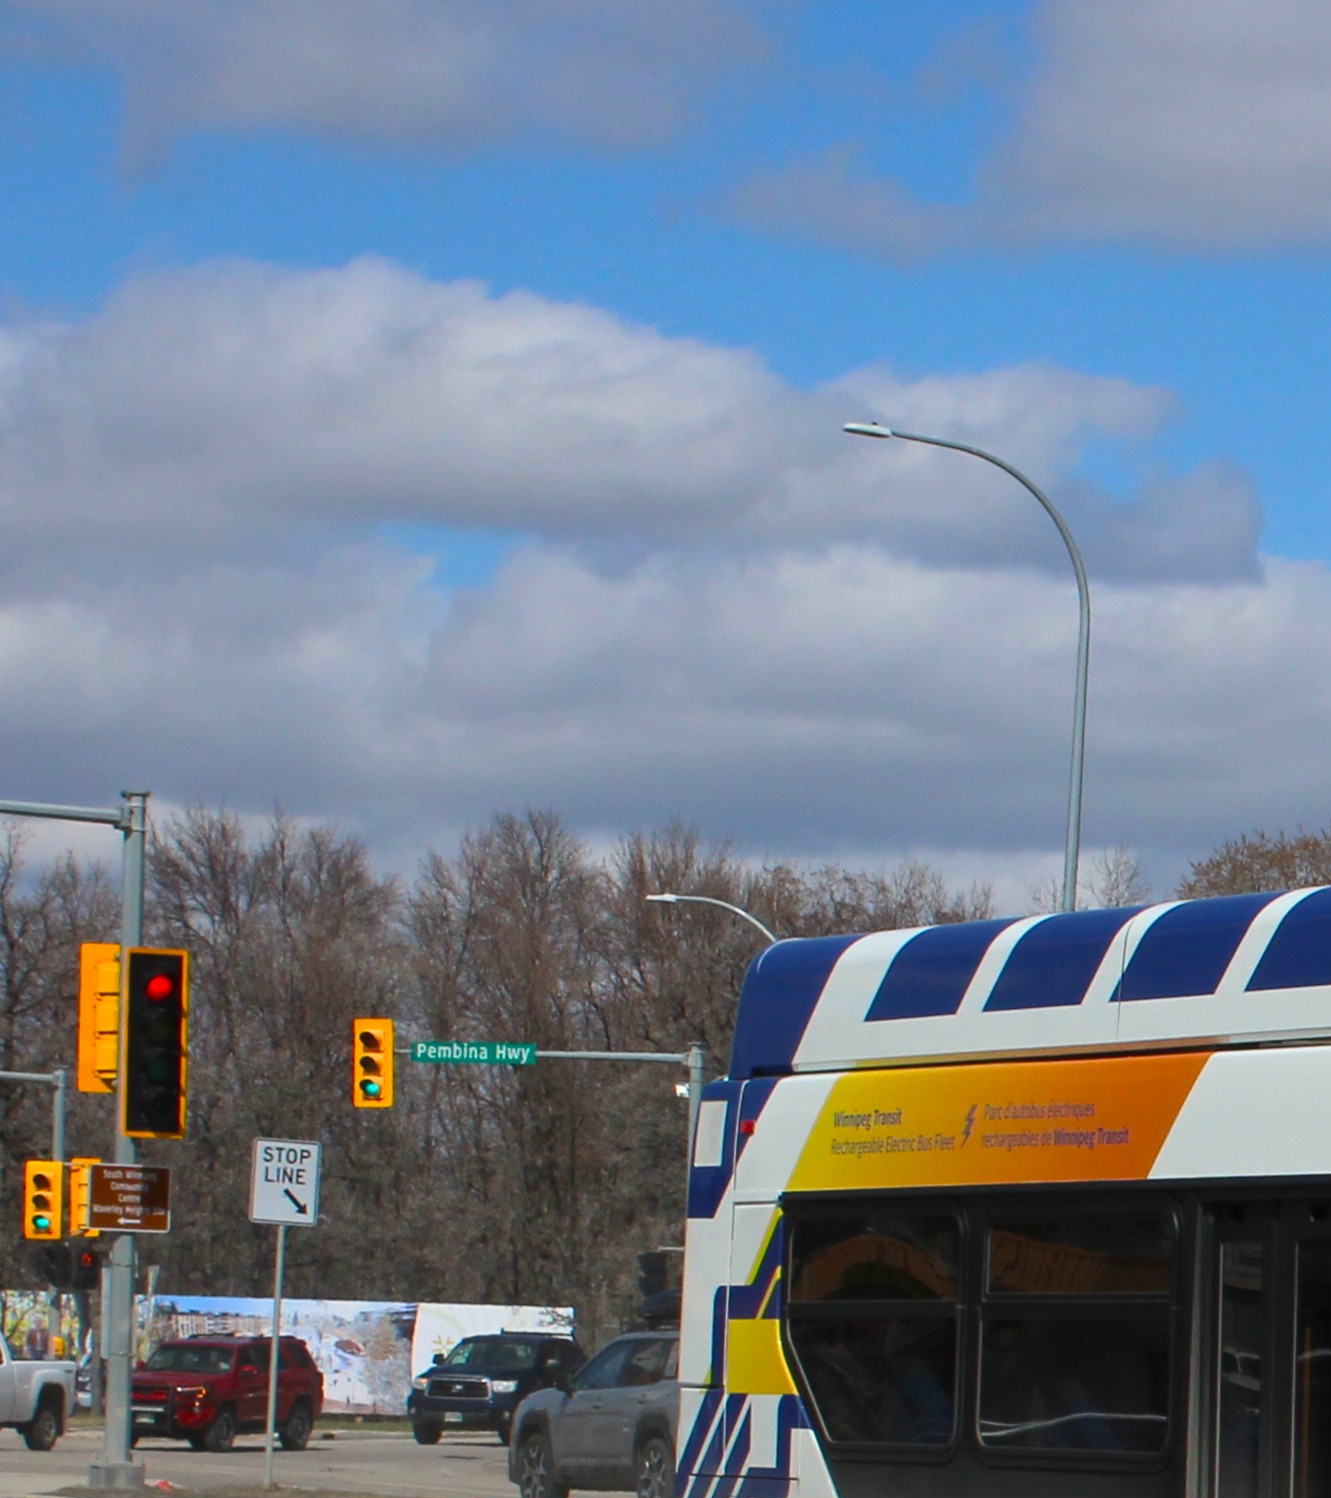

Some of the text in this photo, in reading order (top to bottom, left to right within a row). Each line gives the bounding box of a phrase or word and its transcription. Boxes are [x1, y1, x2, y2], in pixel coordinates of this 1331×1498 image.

[417, 1043, 531, 1065] Pembina Hwy
[834, 1107, 902, 1131] Winnipeg Transit
[917, 1135, 933, 1152] Bus
[934, 1133, 956, 1151] Fleet
[1053, 1127, 1096, 1149] Winnipeg
[1097, 1125, 1130, 1145] Transit
[263, 1146, 311, 1165] STOP
[264, 1166, 306, 1185] LINE
